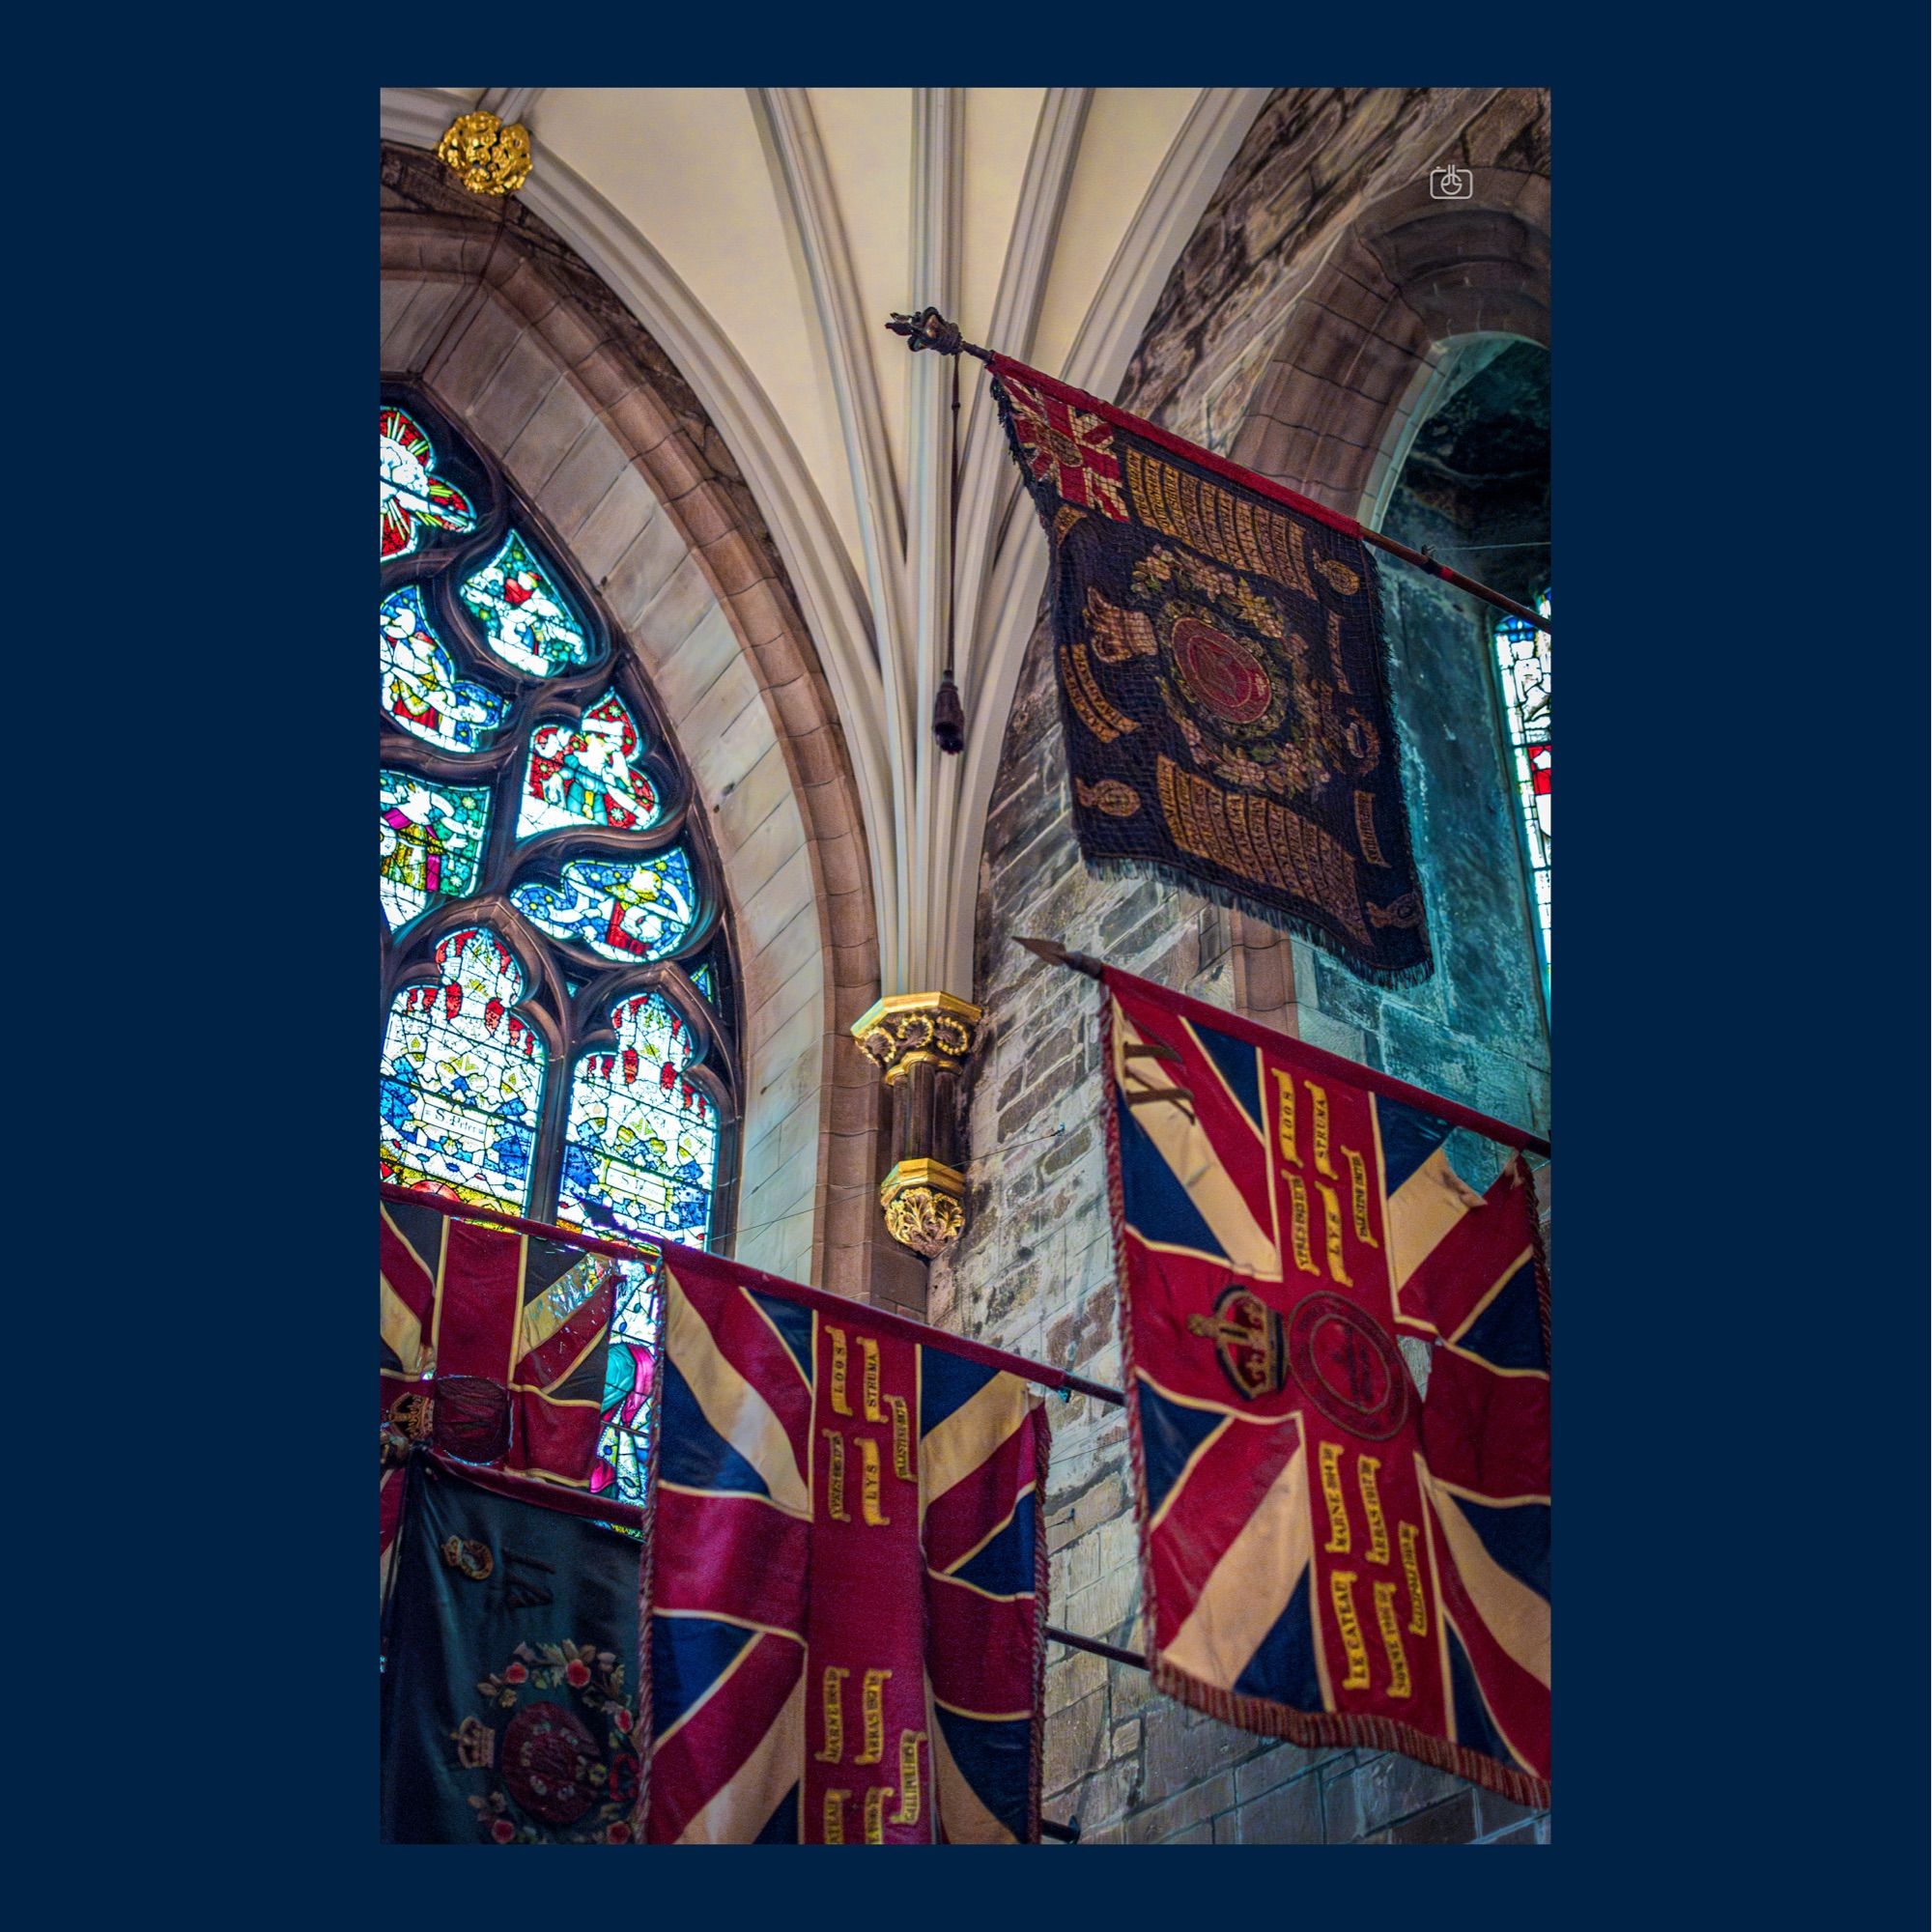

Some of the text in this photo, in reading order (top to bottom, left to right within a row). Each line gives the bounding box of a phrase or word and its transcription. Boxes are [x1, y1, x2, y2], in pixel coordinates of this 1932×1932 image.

[450, 1115, 476, 1132] Peter
[1282, 1090, 1294, 1143] LOOS
[1315, 1098, 1328, 1159] STRUMA
[1293, 1226, 1310, 1267] YPRES
[1328, 1213, 1341, 1256] LYS
[834, 1347, 845, 1394] LOOS
[868, 1353, 880, 1408] STRUMA
[867, 1464, 878, 1501] LYS
[1325, 1491, 1348, 1547] MARNE
[1367, 1507, 1388, 1559] ARRAS
[1333, 1579, 1369, 1681] LE CATEAU
